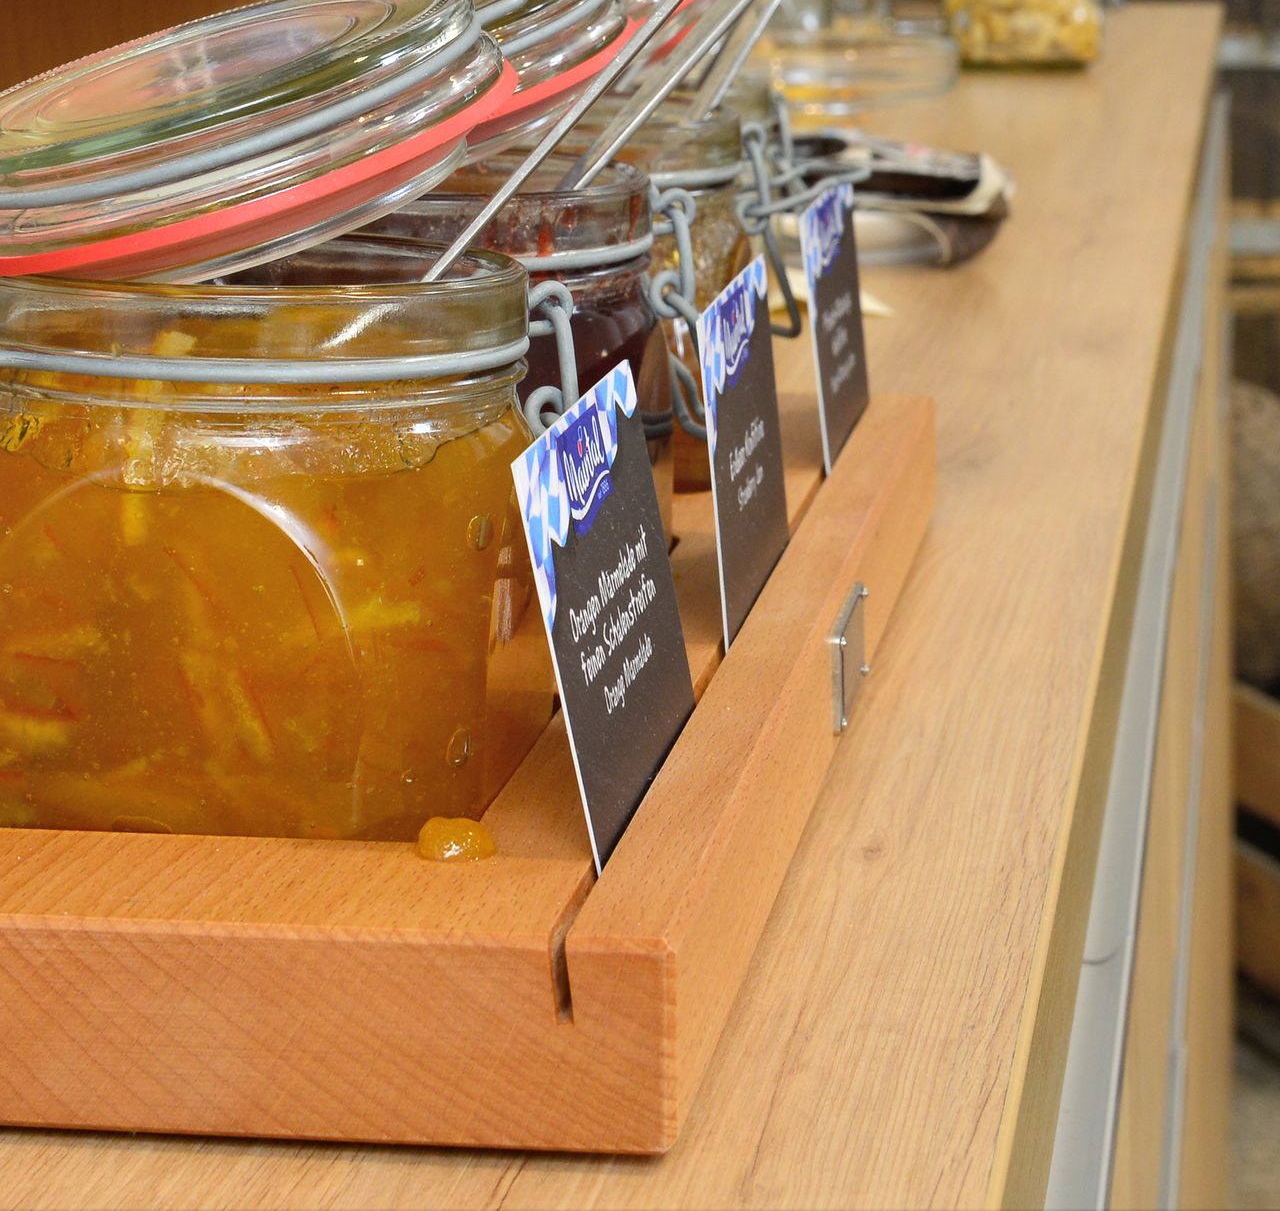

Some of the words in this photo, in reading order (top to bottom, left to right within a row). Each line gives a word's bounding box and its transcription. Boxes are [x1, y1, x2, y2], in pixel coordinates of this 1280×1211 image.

[563, 415, 605, 506] Maintal
[569, 593, 600, 643] Orangen
[597, 542, 637, 607] Marmelade
[634, 523, 649, 564] mit
[580, 644, 607, 687] feinen
[602, 572, 657, 657] Schalenstreifen
[603, 674, 626, 715] Orange
